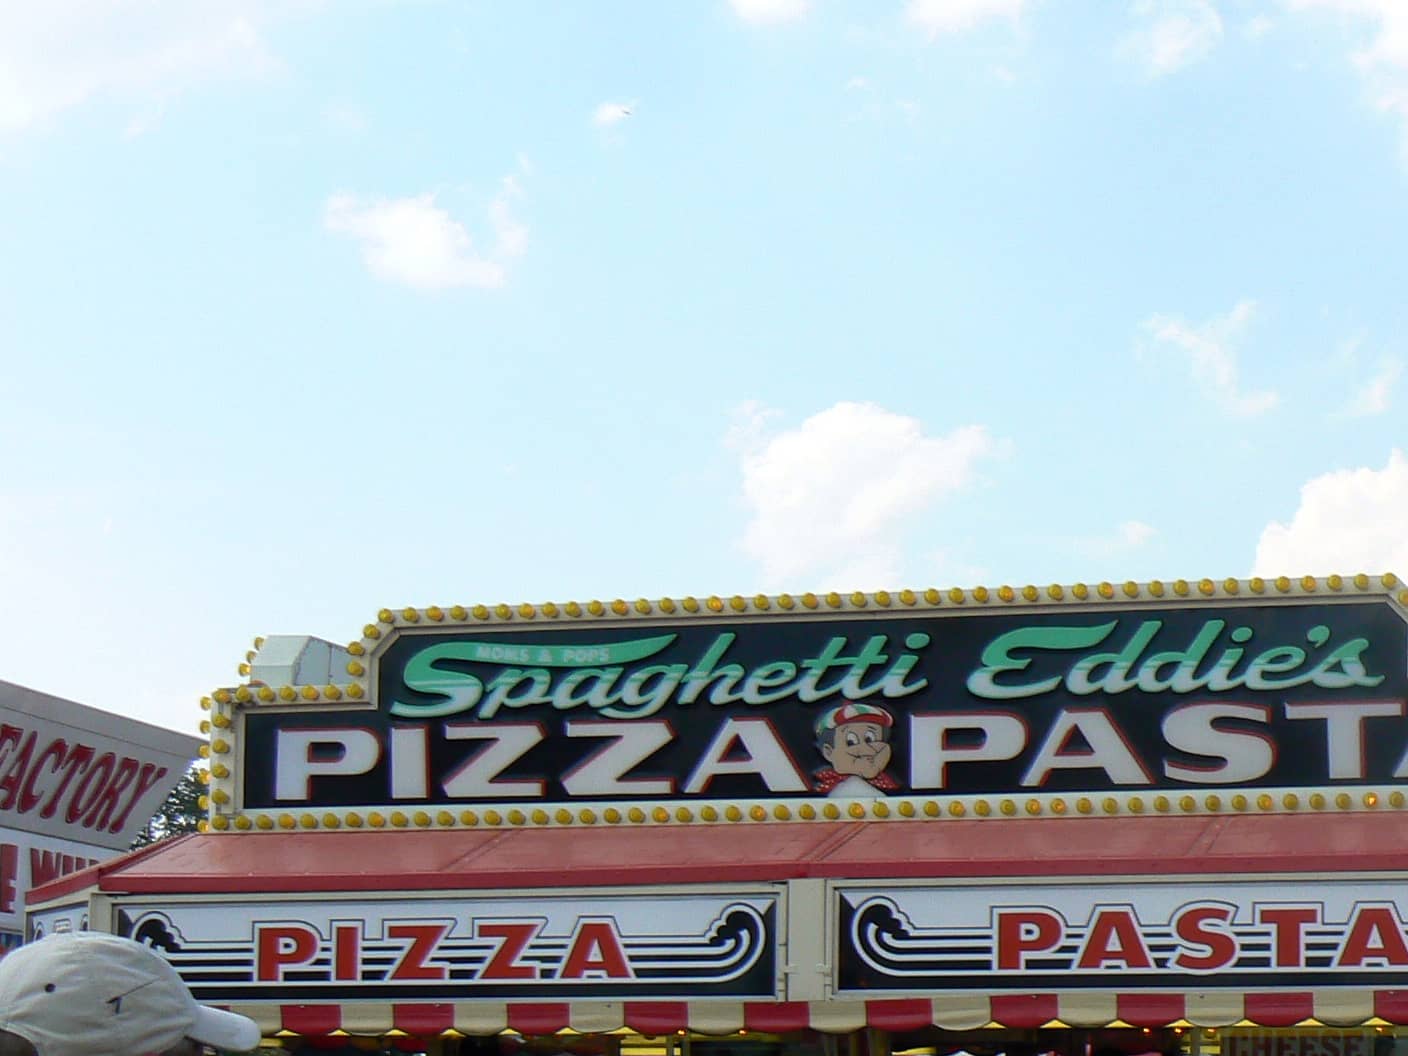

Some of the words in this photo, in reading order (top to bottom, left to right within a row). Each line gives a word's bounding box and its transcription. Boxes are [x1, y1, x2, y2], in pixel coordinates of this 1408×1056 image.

[389, 632, 931, 720] Spaghetti
[966, 617, 1386, 700] Eddie's
[274, 715, 813, 801] PIZZA
[257, 923, 635, 982] PIZZA
